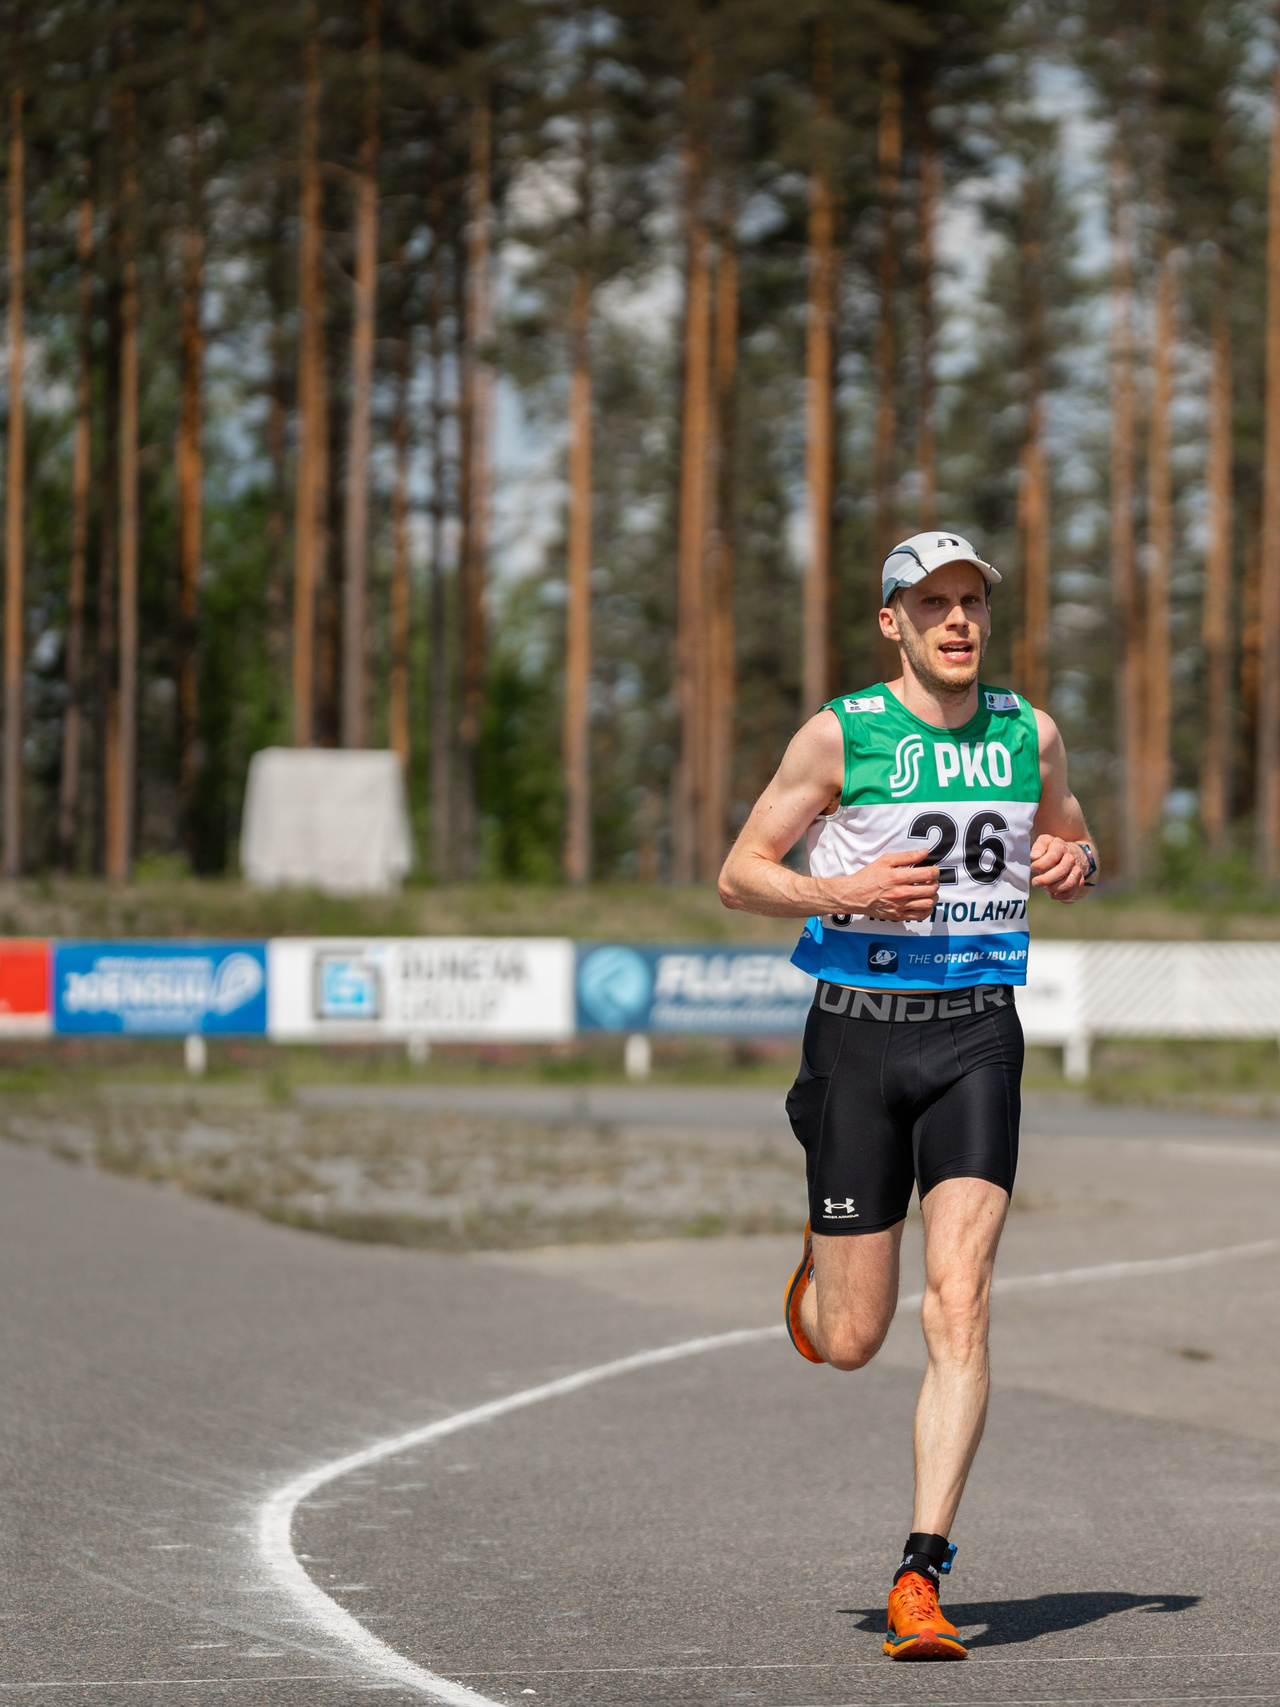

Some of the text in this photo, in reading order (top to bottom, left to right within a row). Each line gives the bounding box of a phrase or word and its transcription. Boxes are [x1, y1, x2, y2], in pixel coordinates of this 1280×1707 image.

[933, 741, 1013, 788] PKO
[907, 810, 1010, 885] 26
[869, 899, 1027, 923] TIOLAHTI
[908, 953, 932, 964] THE
[933, 951, 985, 963] OFFICIAL
[1008, 950, 1027, 961] APP
[819, 983, 1007, 1022] UNDER
